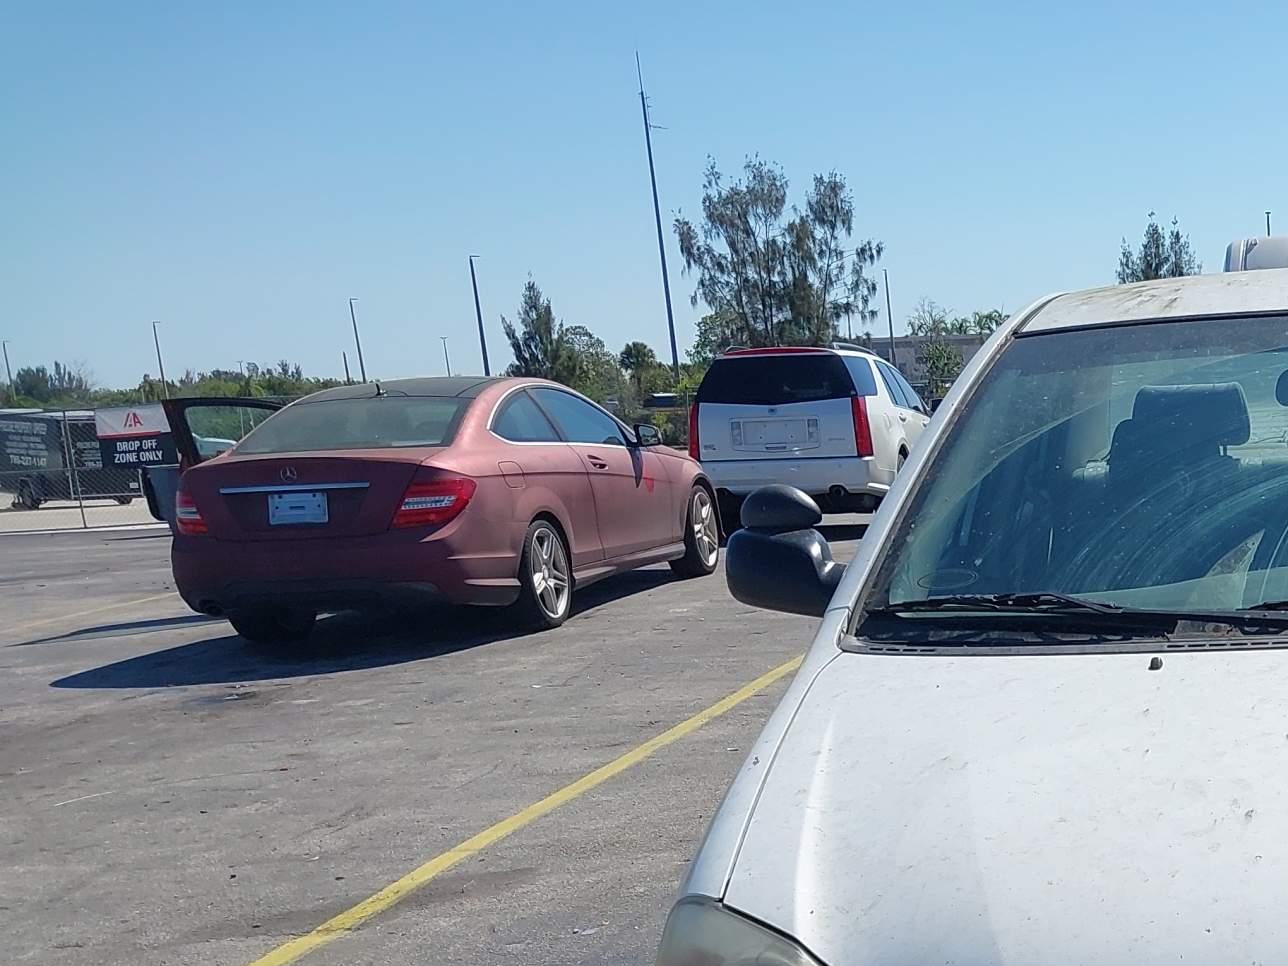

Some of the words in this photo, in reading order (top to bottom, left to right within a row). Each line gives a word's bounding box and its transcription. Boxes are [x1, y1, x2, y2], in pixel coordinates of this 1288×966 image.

[116, 441, 140, 452] DROP
[142, 440, 158, 450] OFF
[113, 453, 138, 463] ZONE
[139, 450, 163, 462] ONLY
